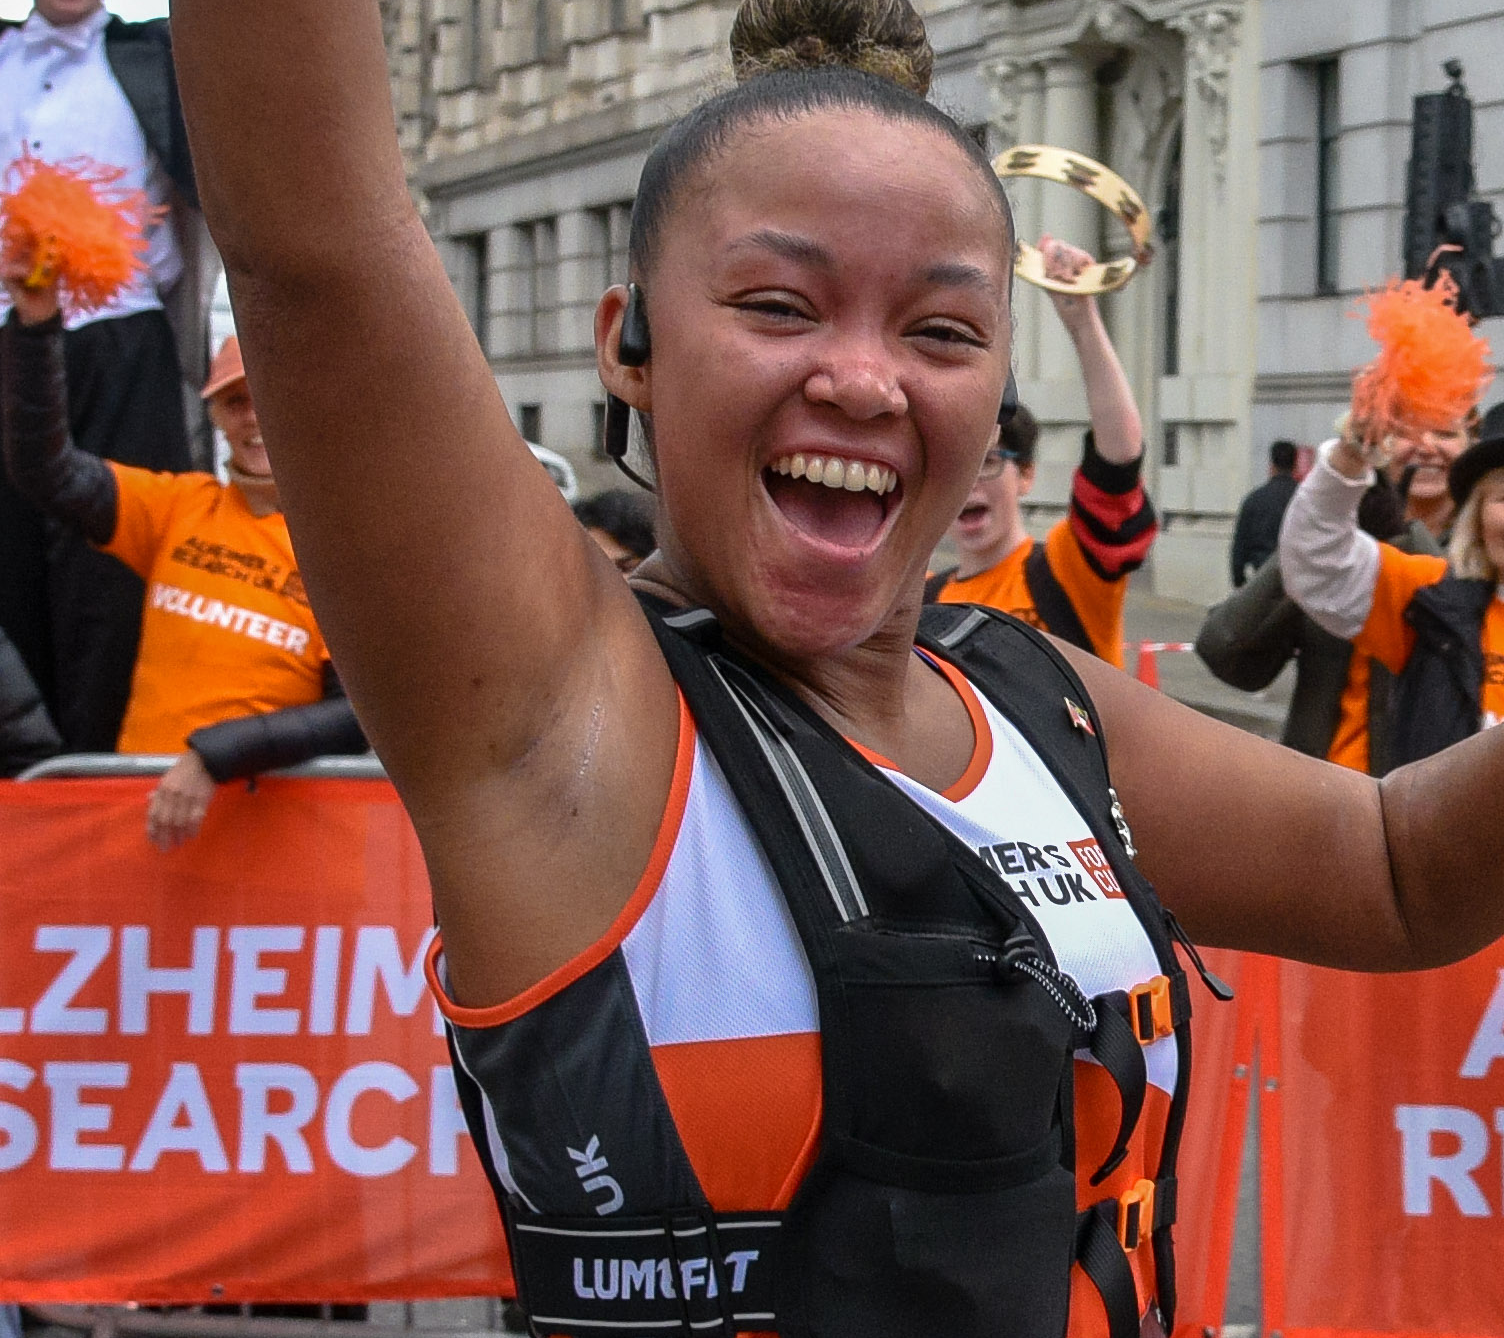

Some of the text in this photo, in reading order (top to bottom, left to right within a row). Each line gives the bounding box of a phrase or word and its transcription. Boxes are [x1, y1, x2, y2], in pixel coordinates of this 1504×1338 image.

[152, 581, 310, 657] VOLUNTEER
[1036, 872, 1098, 906] UK
[566, 1133, 624, 1216] UK
